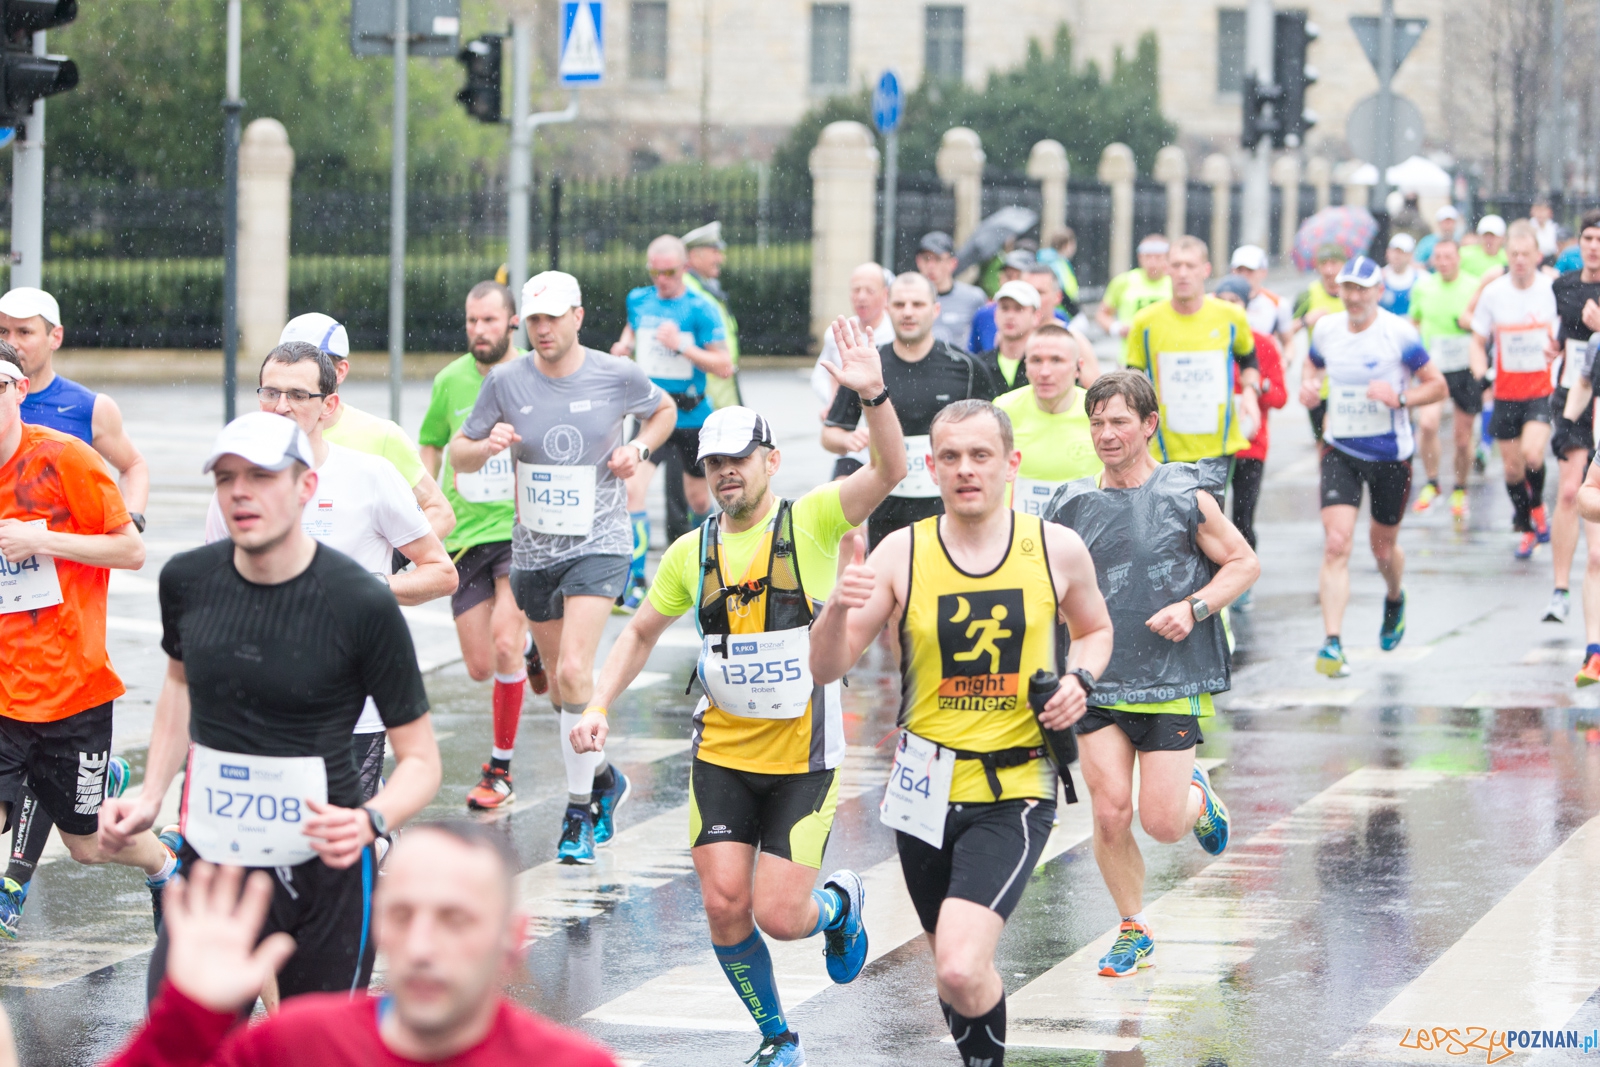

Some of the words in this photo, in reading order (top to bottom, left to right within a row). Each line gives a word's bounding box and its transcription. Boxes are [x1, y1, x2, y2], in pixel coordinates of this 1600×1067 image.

[1171, 368, 1214, 383] 4265
[525, 486, 580, 507] 11435
[720, 657, 802, 685] 13255
[751, 686, 776, 694] Robert
[954, 673, 1006, 695] night
[938, 695, 1018, 712] runners
[74, 750, 108, 815] NIKE
[205, 787, 301, 823] 12708
